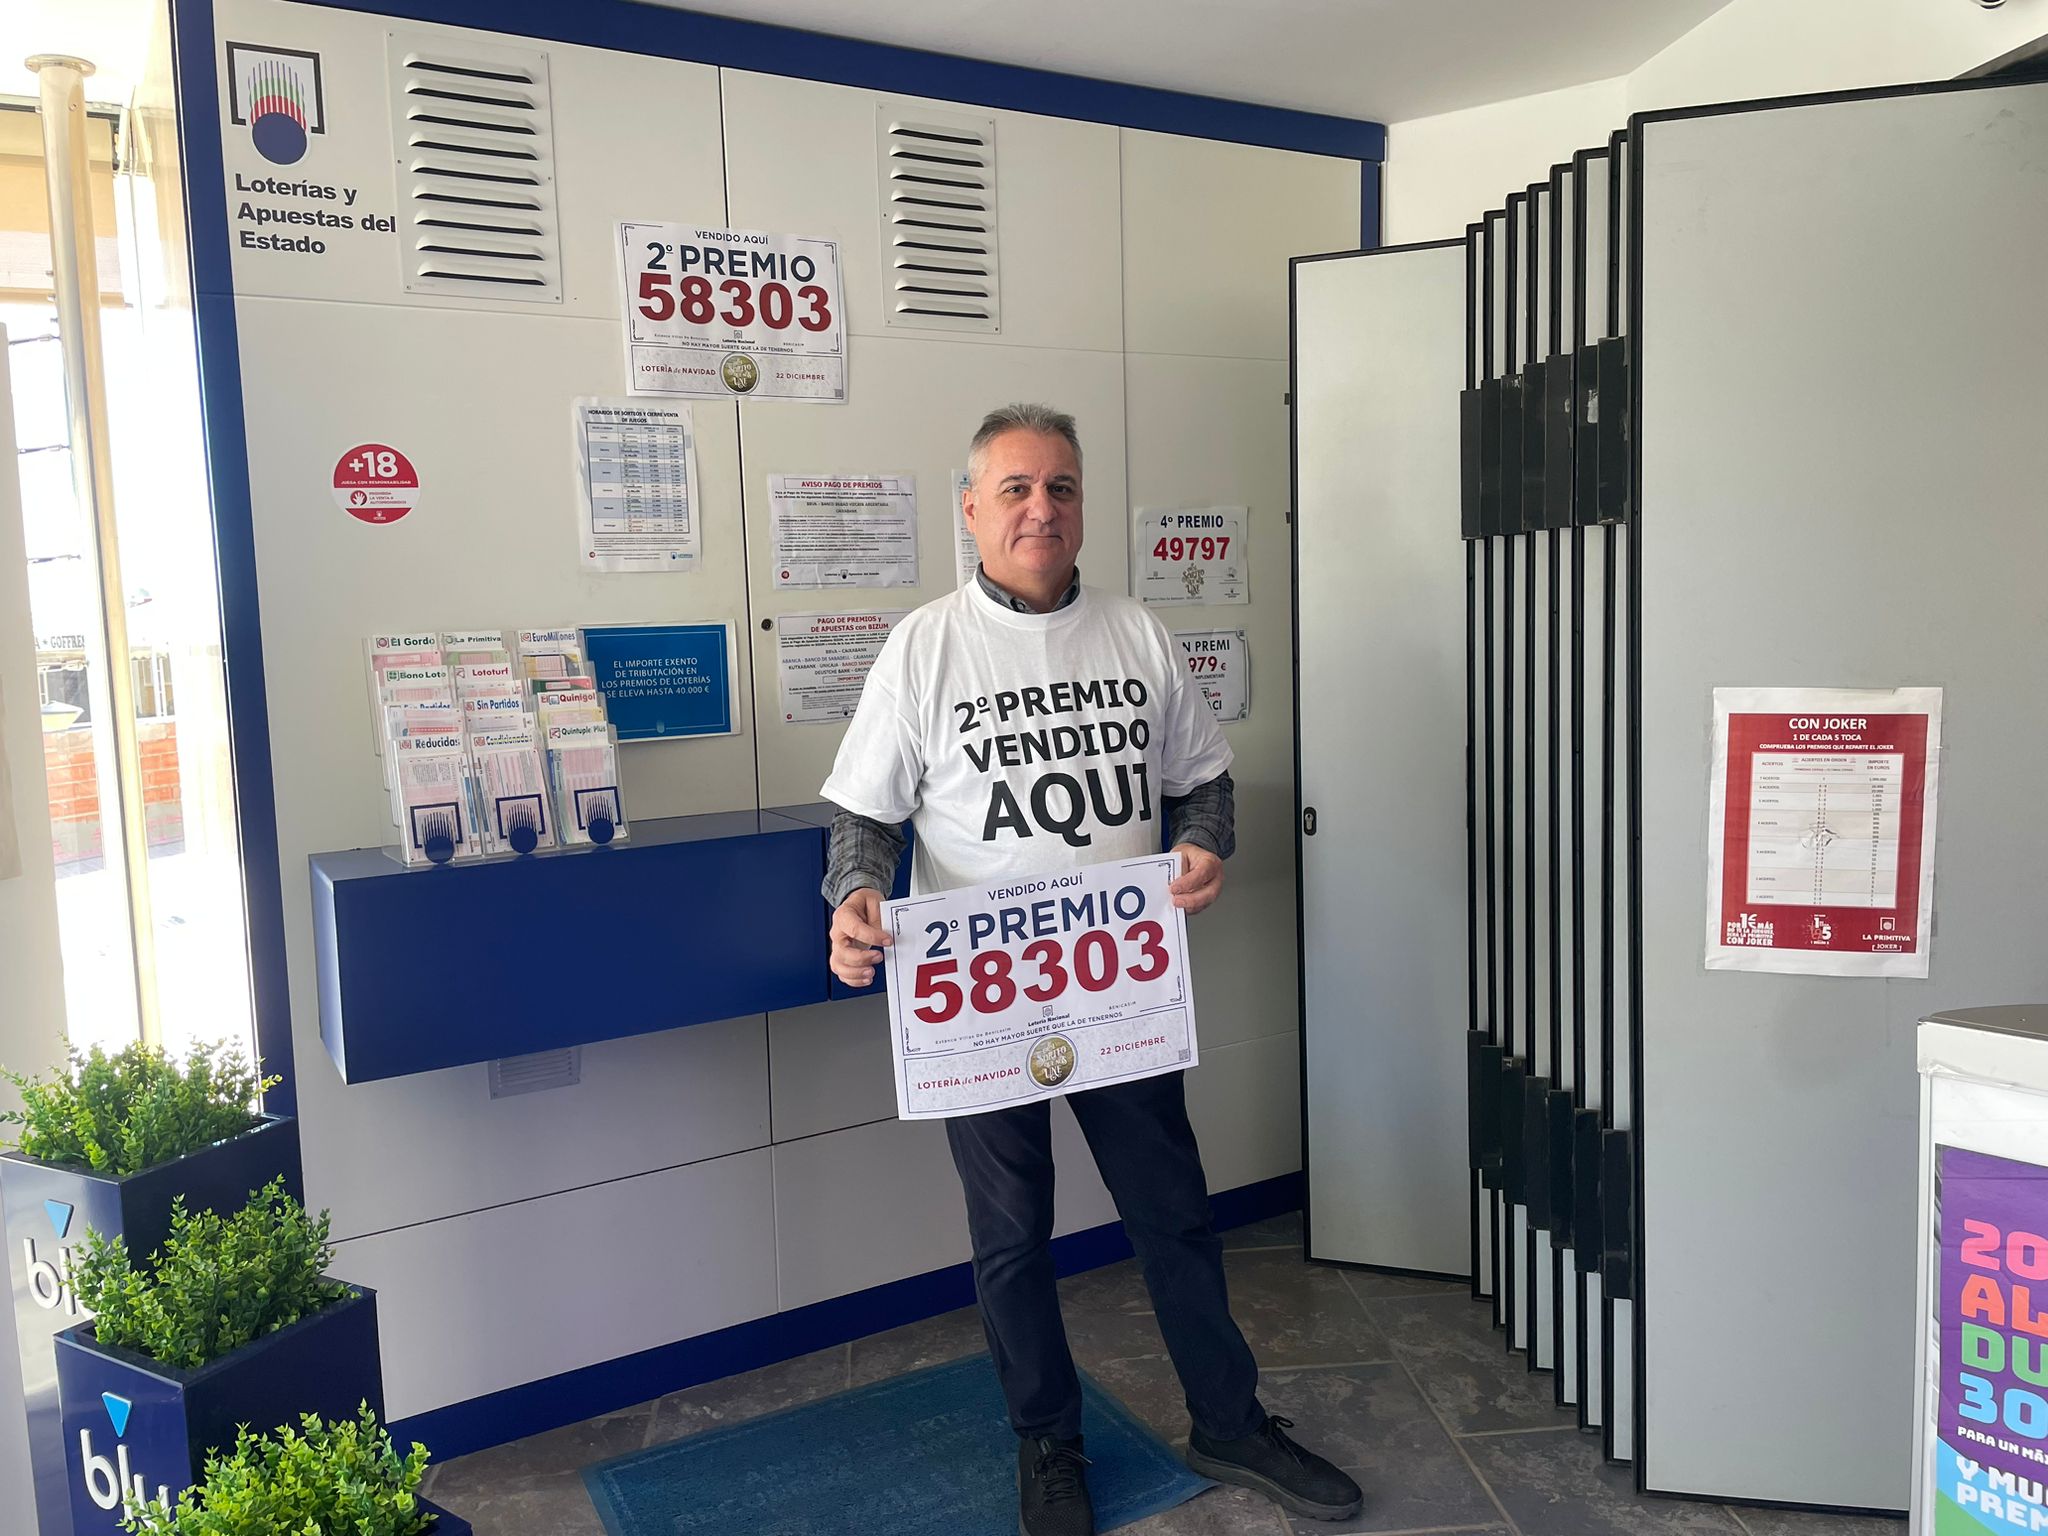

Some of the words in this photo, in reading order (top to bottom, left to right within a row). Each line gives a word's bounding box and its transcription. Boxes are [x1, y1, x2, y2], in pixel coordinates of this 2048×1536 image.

[235, 173, 337, 200] Loterías
[343, 186, 357, 206] y
[237, 202, 354, 230] Apuestas
[361, 213, 397, 233] del
[240, 230, 326, 254] Estado
[694, 230, 741, 243] VENDIDO
[743, 234, 769, 245] AQUÍ
[646, 241, 674, 271] 2º
[680, 244, 816, 283] PREMIO
[638, 272, 832, 332] 58303
[641, 364, 673, 374] LOTERÍA
[682, 367, 716, 376] NAVIDAD
[786, 373, 826, 381] DICIEMBRE
[349, 451, 398, 478] +18
[1160, 515, 1174, 528] 4º
[1178, 515, 1224, 528] PREMIO
[1153, 537, 1230, 561] 49797
[821, 624, 854, 632] APUESTAS
[391, 637, 400, 646] El
[404, 637, 435, 647] Gordo
[532, 632, 576, 642] EuroMillones
[1195, 639, 1230, 652] PREMI
[626, 660, 663, 668] IMPORTE
[665, 658, 698, 666] EXENTO
[1221, 662, 1226, 671] €
[400, 672, 424, 680] Bono
[426, 671, 446, 679] Loto
[472, 667, 508, 676] Lototurf
[615, 670, 626, 678] DE
[629, 667, 683, 677] TRIBUTACIÓN
[602, 681, 618, 689] LOS
[620, 679, 657, 688] PREMIOS
[673, 675, 711, 685] LOTERÍAS
[560, 693, 595, 703] Quinigol
[607, 691, 616, 699] SE
[619, 689, 645, 698] ELEVA
[647, 688, 674, 696] HASTA
[477, 700, 489, 710] Sin
[490, 699, 519, 709] Partidos
[954, 696, 991, 734] 2º
[995, 678, 1148, 722] PREMIO
[1789, 718, 1819, 729] CON
[1823, 718, 1867, 730] JOKER
[415, 736, 461, 749] Reducidas
[962, 718, 1150, 773] VENDIDO
[987, 881, 1046, 901] VENDIDO
[1050, 872, 1084, 890] AQUÍ
[925, 919, 961, 958] 2º
[968, 885, 1146, 950] PREMIO
[1822, 926, 1832, 940] 5
[1746, 937, 1773, 946] JOKER
[913, 920, 1170, 1024] 58303
[1047, 1013, 1070, 1022] Nacional
[1001, 1031, 1025, 1041] MAYOR
[1026, 1025, 1050, 1035] SUERTE
[1088, 1011, 1123, 1022] TENERNOS
[1100, 1046, 1111, 1055] 22
[1115, 1035, 1166, 1053] DICIEMBRE
[918, 1076, 961, 1089] LOTERÍA
[974, 1066, 1021, 1082] NAVIDAD
[1961, 1218, 2048, 1280] 20
[24, 1237, 99, 1320] bl
[1961, 1273, 2048, 1338] AL
[1959, 1372, 2048, 1439] 30
[1957, 1426, 1996, 1447] PARA
[1998, 1439, 2019, 1455] UN
[1956, 1456, 1979, 1481] Y
[1988, 1466, 2048, 1506] MU
